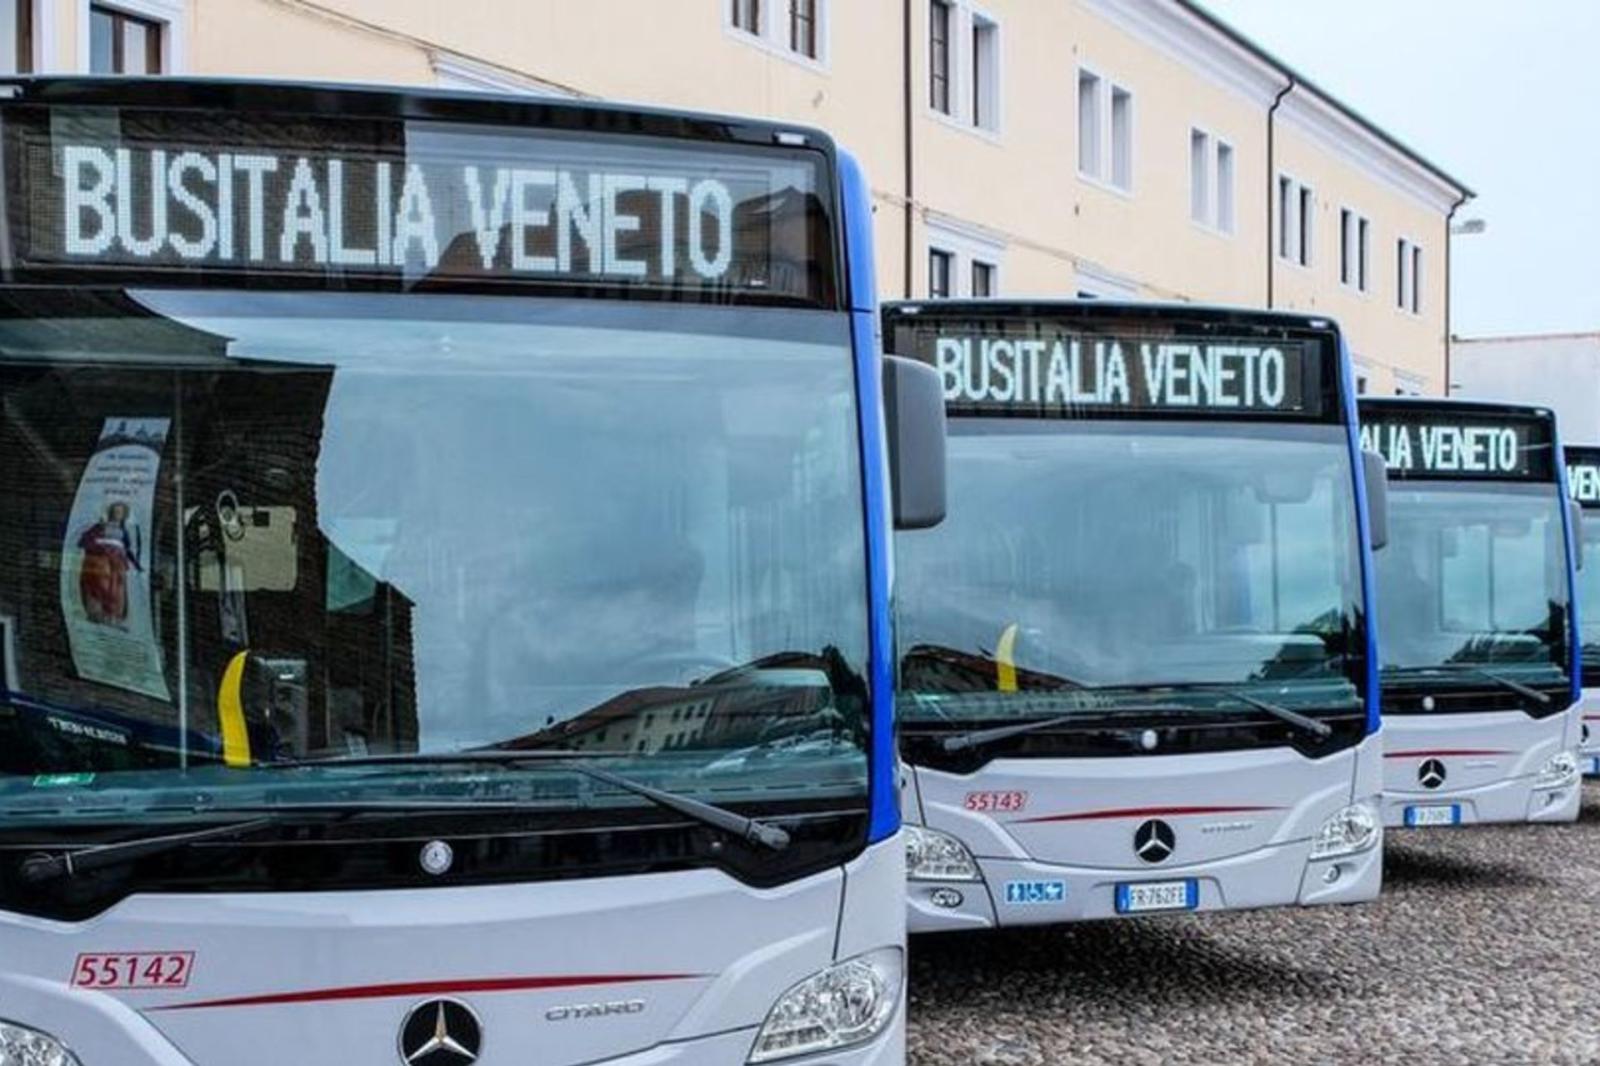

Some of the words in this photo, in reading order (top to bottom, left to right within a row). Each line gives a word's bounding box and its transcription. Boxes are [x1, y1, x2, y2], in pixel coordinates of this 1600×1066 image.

[62, 145, 440, 268] BUSITALIA
[464, 165, 733, 279] VENETO
[936, 337, 1131, 405] BUSITALIA
[1140, 343, 1285, 407] VENETO
[1419, 425, 1518, 472] VENETO
[966, 792, 1023, 811] 55143
[77, 956, 186, 986] 55142
[544, 999, 645, 1021] CITARO
